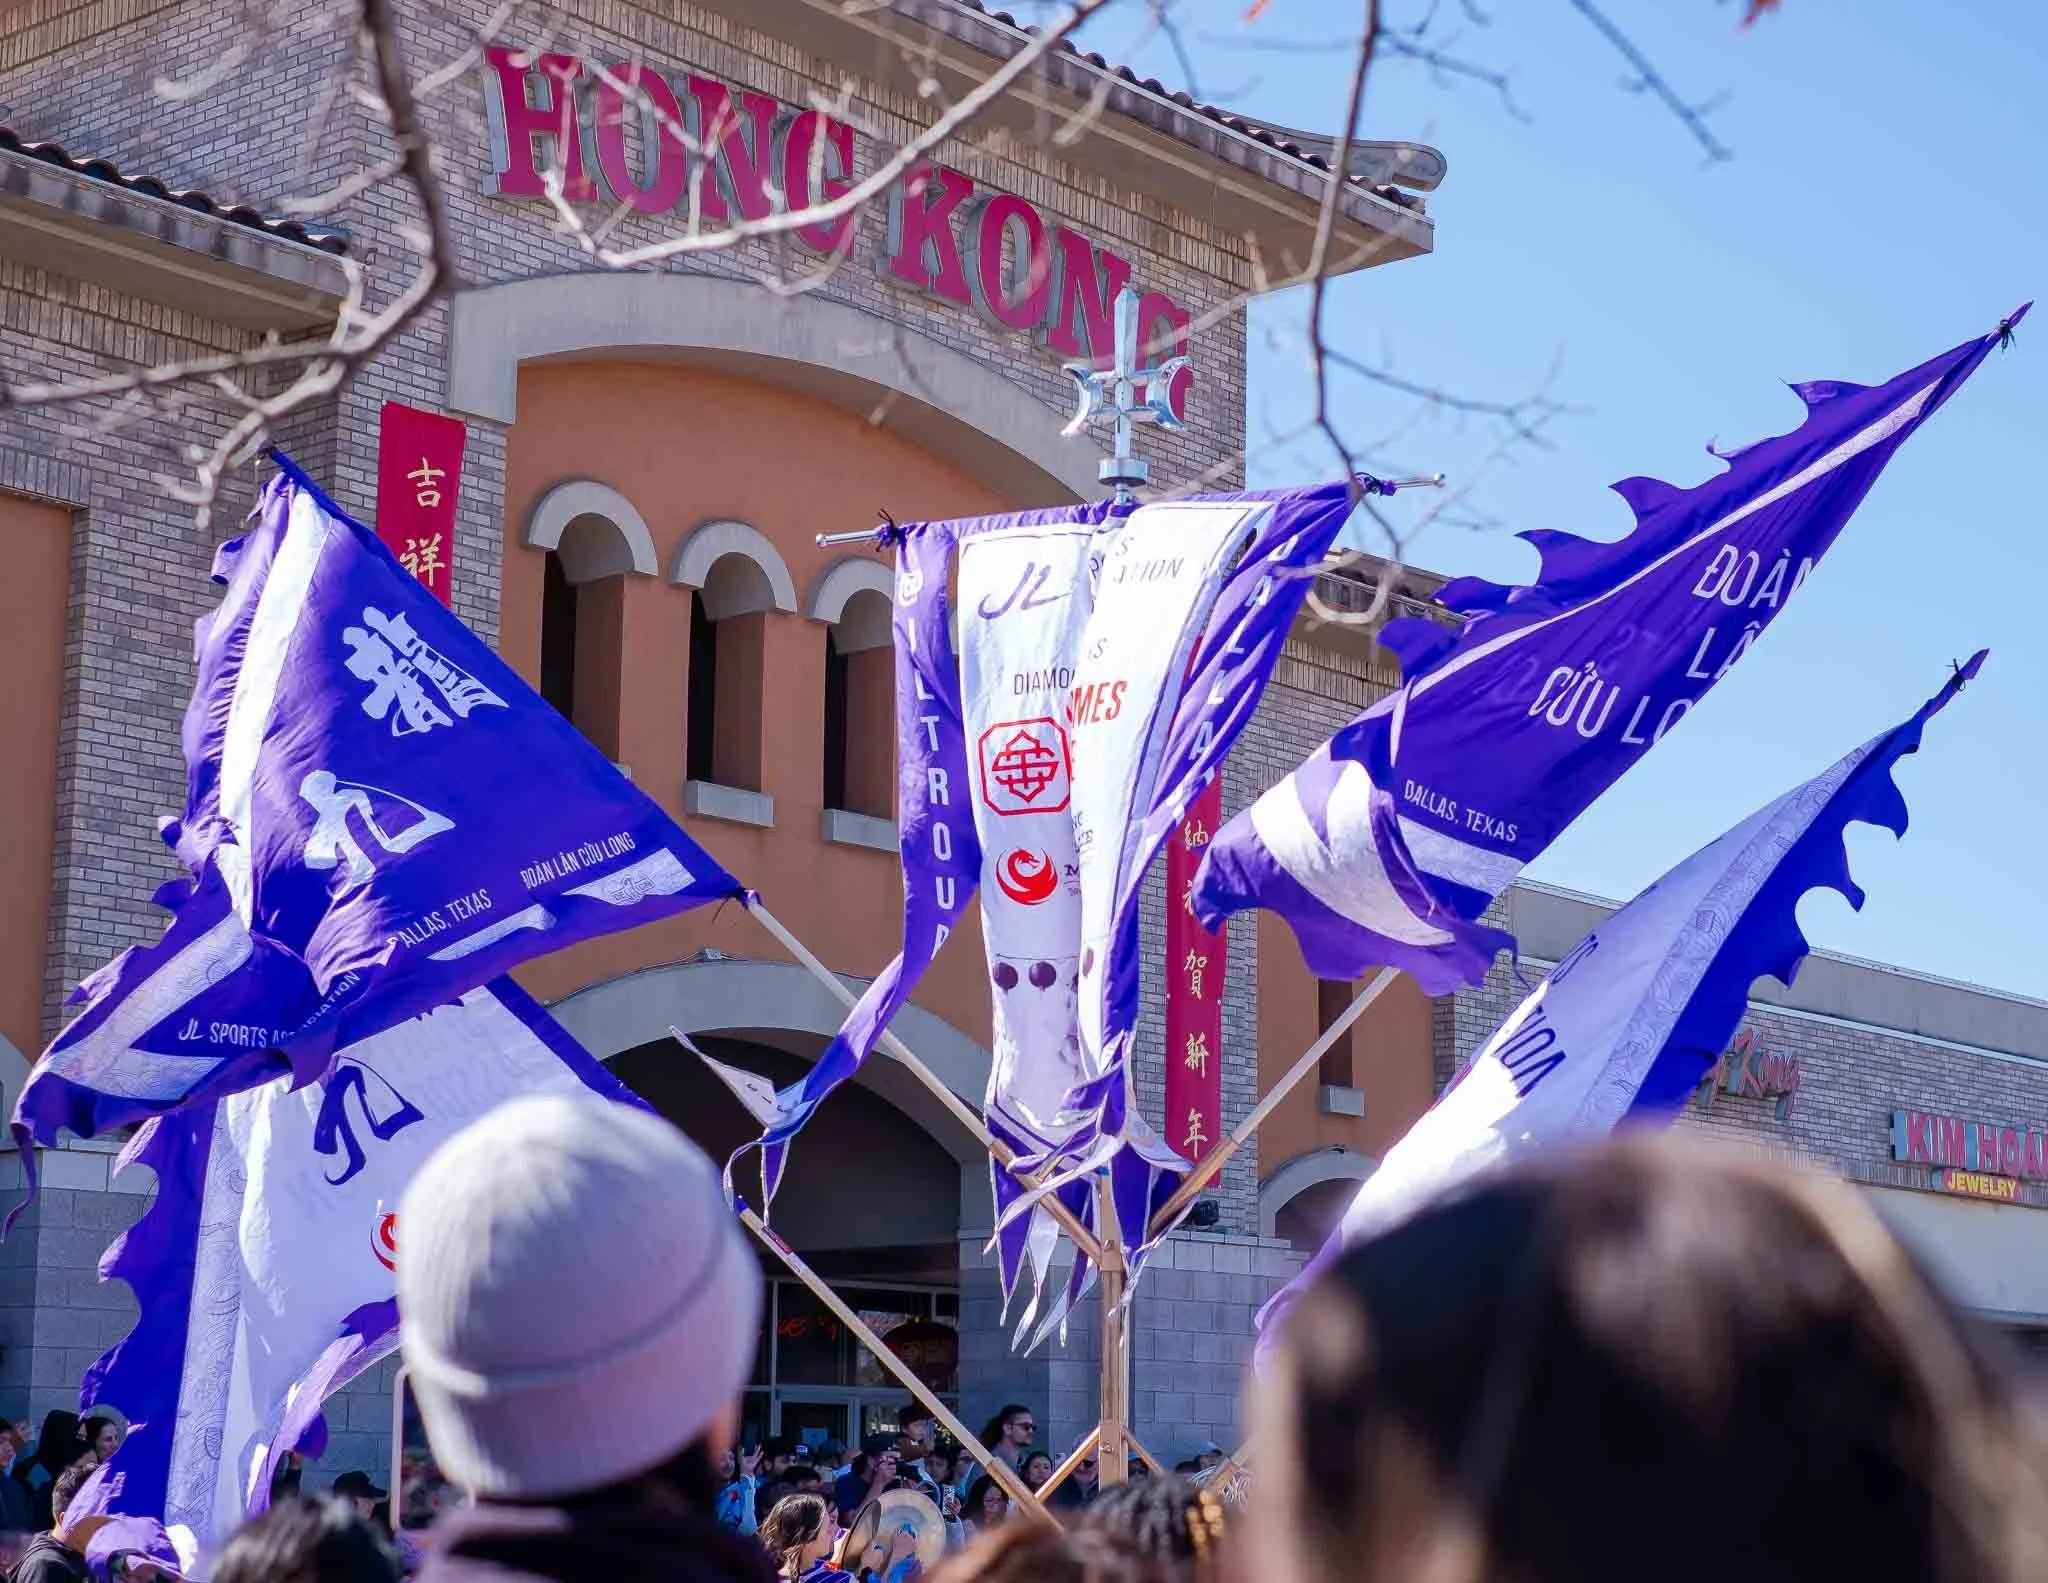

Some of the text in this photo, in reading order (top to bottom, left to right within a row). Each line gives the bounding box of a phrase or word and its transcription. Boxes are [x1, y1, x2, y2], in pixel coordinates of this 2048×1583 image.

[482, 46, 1194, 424] HONG KONG
[400, 455, 446, 588] 吉祥
[1066, 680, 1128, 729] MES
[1404, 779, 1519, 843] DALLAS, TEXAS
[600, 831, 636, 860] LONG
[445, 888, 493, 922] TEXAS
[177, 1017, 206, 1042] JL
[208, 1021, 269, 1049] SPORTS
[1903, 1109, 1967, 1169] KIM
[1947, 1171, 2017, 1199] JEWELRY
